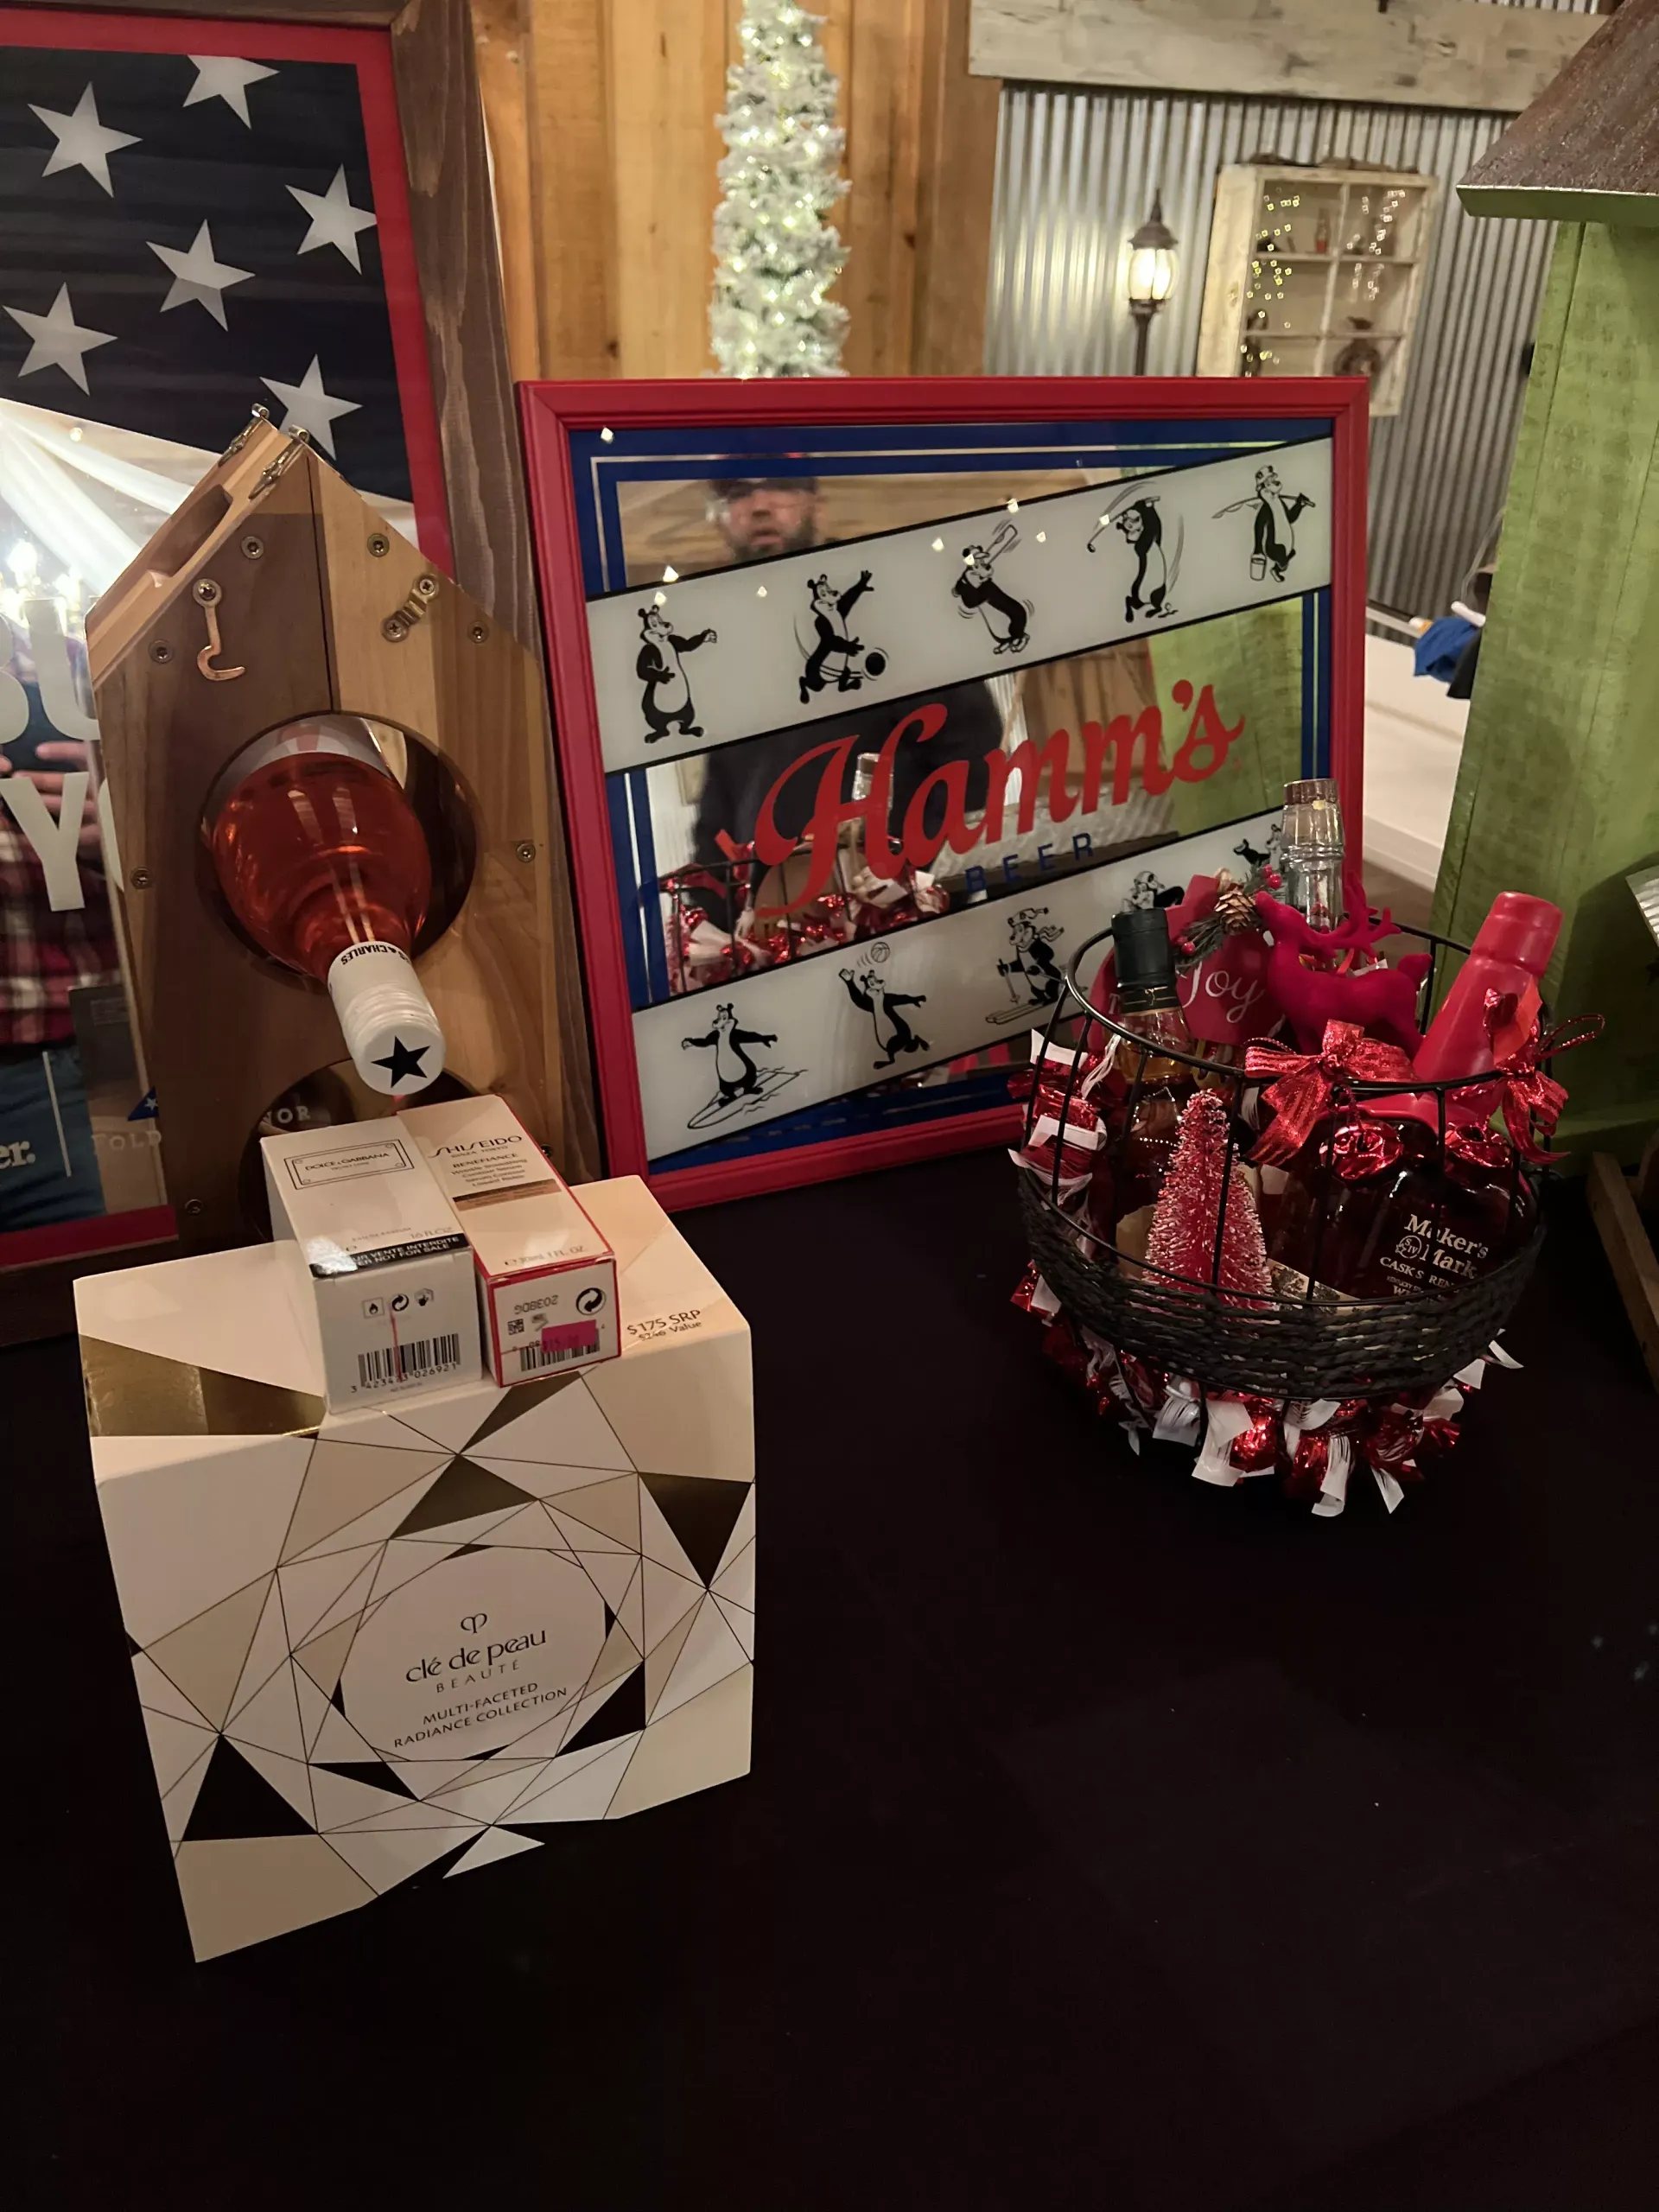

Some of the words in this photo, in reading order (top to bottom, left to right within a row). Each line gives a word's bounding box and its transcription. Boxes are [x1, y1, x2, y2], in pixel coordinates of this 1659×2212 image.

[753, 679, 1246, 918] Hamm's
[964, 832, 1095, 895] BEER
[340, 944, 388, 965] CHARLES
[1176, 959, 1266, 1023] Joy
[428, 1135, 522, 1159] SHISEIDO
[452, 1153, 518, 1169] BENEFIANCE
[370, 1246, 404, 1259] VENTE
[406, 1236, 460, 1250] INTERDITE
[375, 1254, 397, 1263] NOT
[399, 1249, 422, 1258] FOR
[423, 1243, 450, 1253] SALE
[1380, 1256, 1414, 1277] CASK
[626, 1318, 667, 1335] $175
[668, 1309, 701, 1325] SRP
[669, 1321, 702, 1332] Value
[414, 1363, 457, 1379] 026921
[405, 1654, 442, 1682] clé
[448, 1647, 480, 1671] de
[486, 1630, 548, 1666] peau
[423, 1682, 538, 1726] MULTI-FACETED
[394, 1718, 472, 1748] RADIANCE
[476, 1687, 569, 1722] COLLECTION
